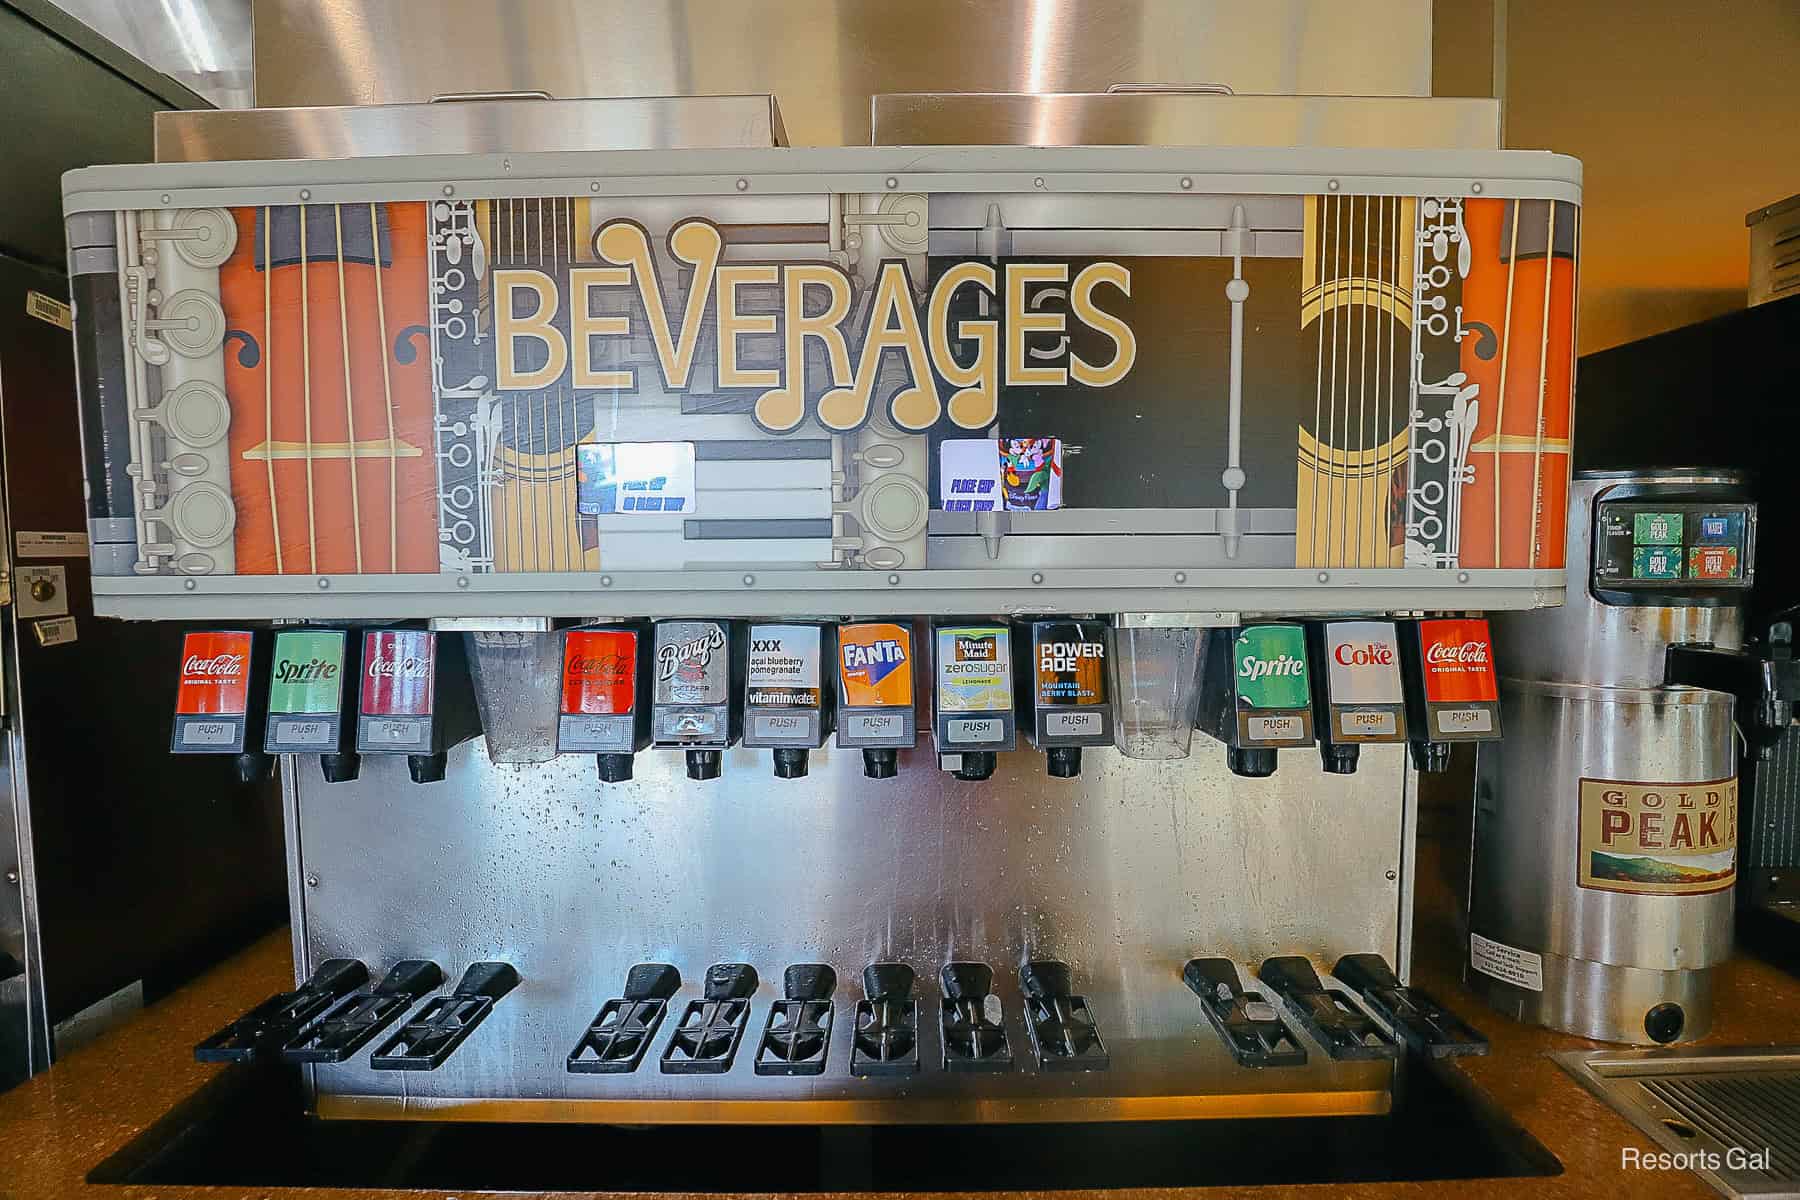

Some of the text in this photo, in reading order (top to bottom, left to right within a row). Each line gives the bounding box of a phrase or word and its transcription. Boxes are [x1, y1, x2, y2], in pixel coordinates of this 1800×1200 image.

[493, 221, 1136, 430] BEVERAGES
[959, 641, 993, 650] Minute
[1041, 643, 1104, 657] POWER
[843, 641, 905, 667] FANTA
[1335, 644, 1392, 666] Coke
[1427, 641, 1488, 663] Coca-Cola
[183, 654, 244, 676] Coca-Cola
[767, 656, 804, 667] blueberry
[275, 658, 338, 684] Sprite
[751, 666, 801, 675] pomegranate
[1239, 655, 1303, 681] Sprite
[863, 717, 890, 727] PUSH
[1061, 716, 1088, 725] PUSH
[1356, 715, 1383, 724] PUSH
[1451, 712, 1479, 721] PUSH
[768, 718, 797, 728] PUSH
[962, 722, 990, 732] PUSH
[1263, 720, 1291, 729] PUSH
[198, 724, 223, 734] PUSH
[290, 724, 318, 734] PUSH
[1602, 790, 1721, 809] GOLD
[1728, 784, 1737, 841] TEA
[1601, 809, 1721, 850] PEAK
